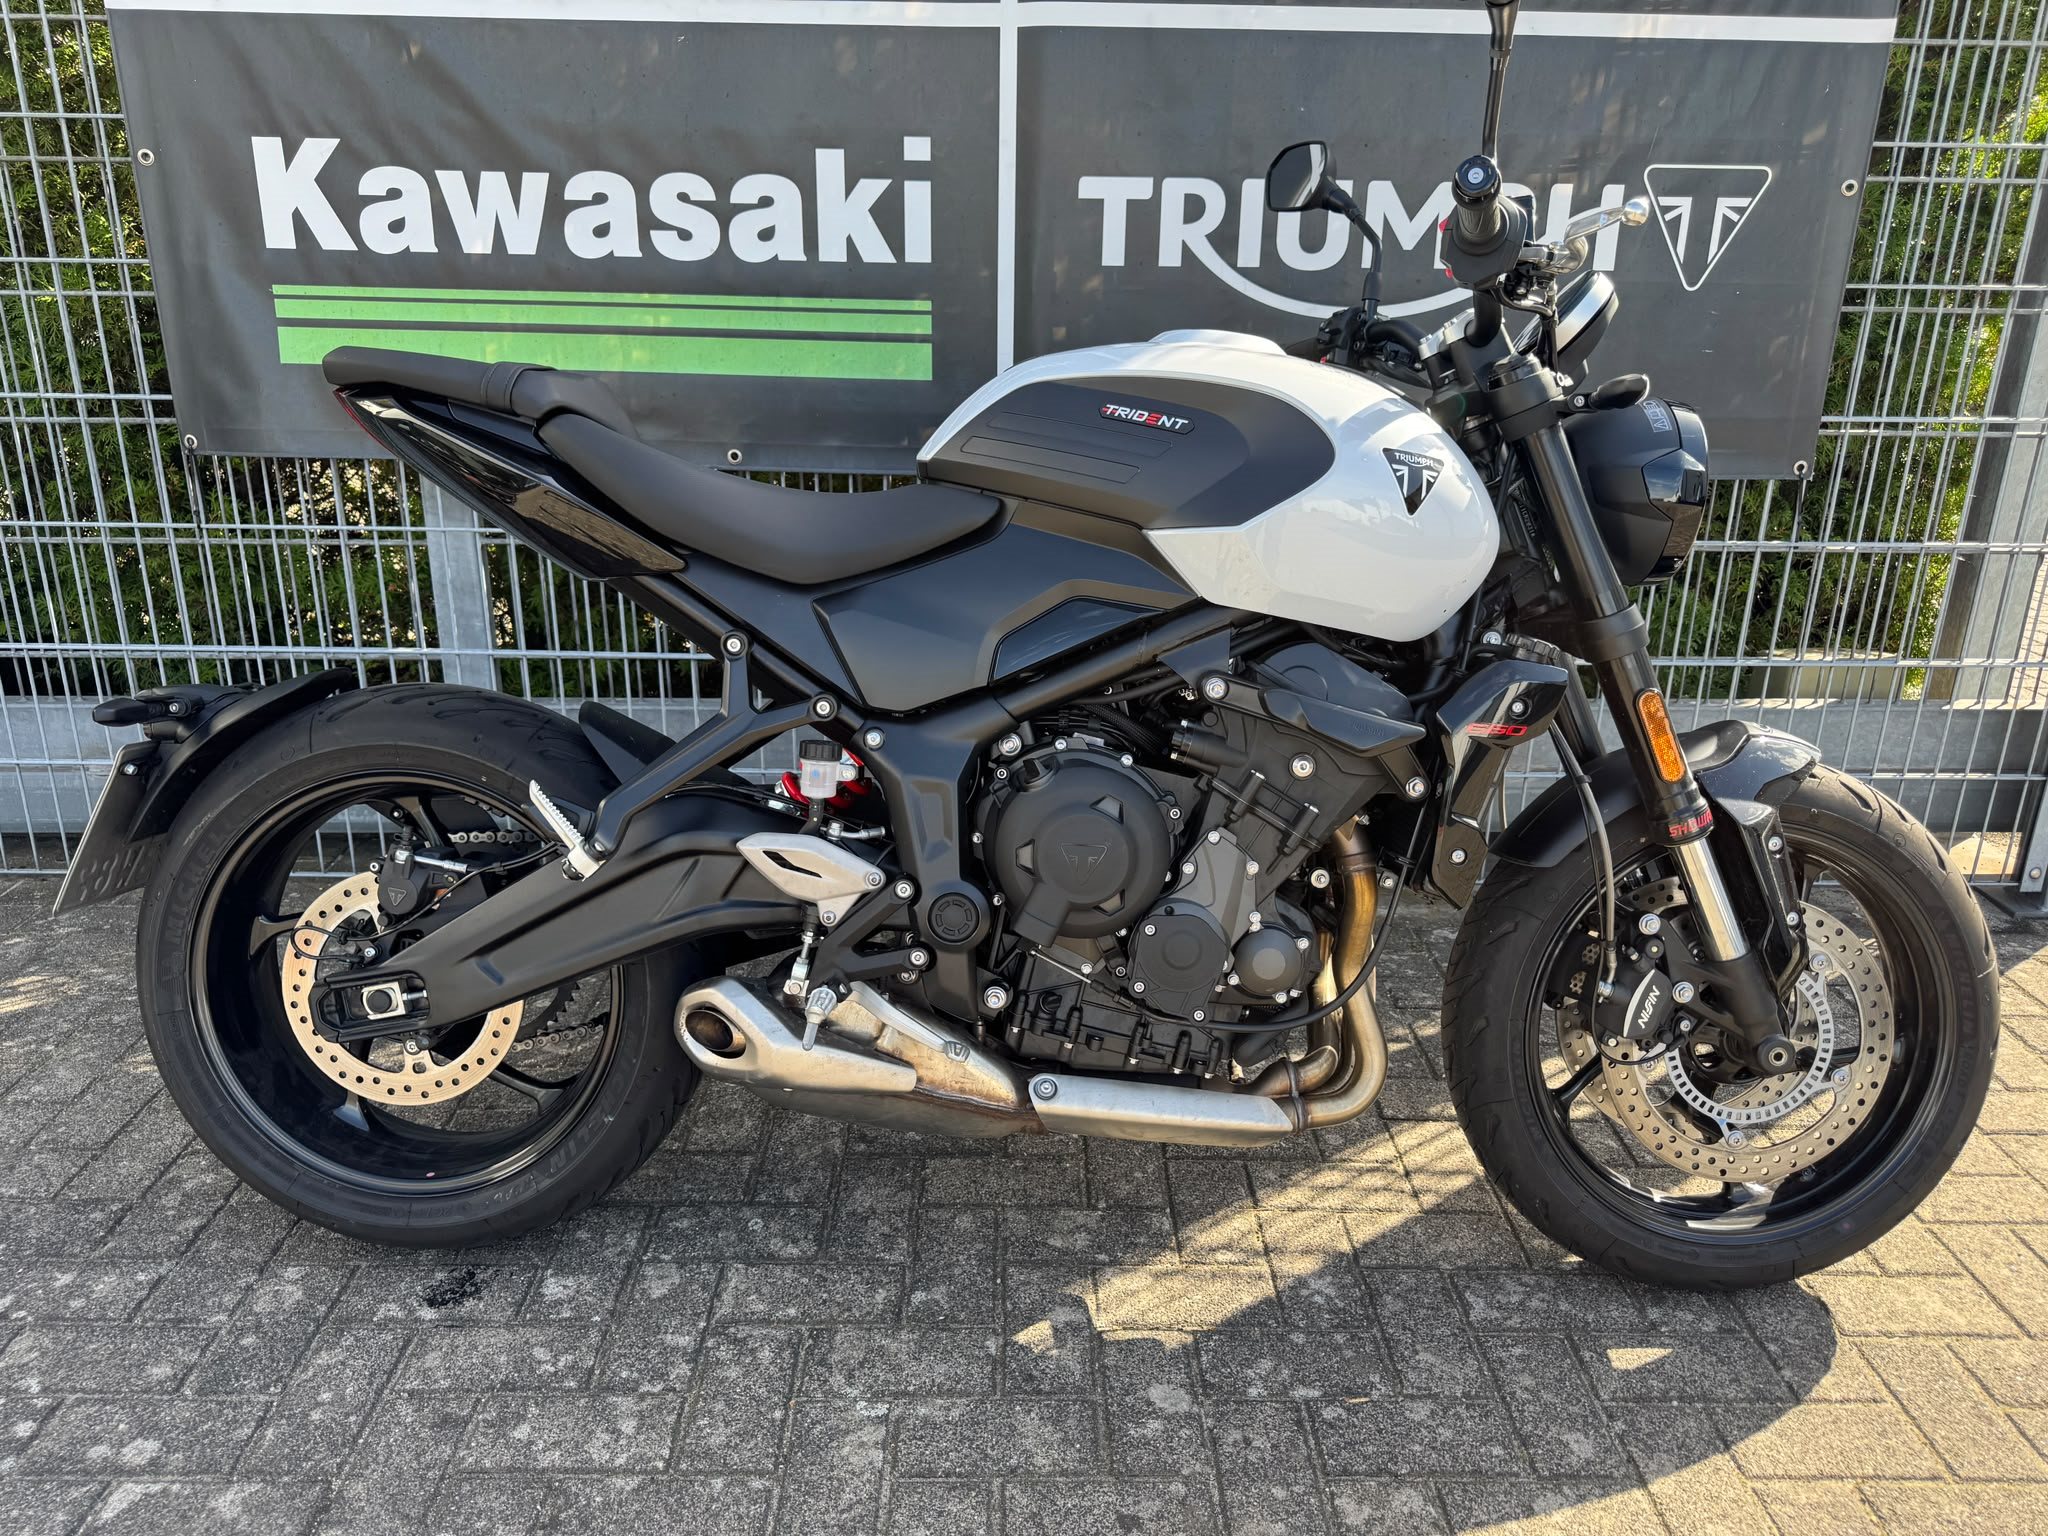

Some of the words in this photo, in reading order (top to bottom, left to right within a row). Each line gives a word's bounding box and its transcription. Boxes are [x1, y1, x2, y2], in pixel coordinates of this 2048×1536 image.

[251, 136, 932, 264] Kawasaki
[1078, 176, 1626, 319] TRIUMH
[1102, 403, 1189, 430] TRIDENT
[1394, 452, 1434, 467] TRIUMPH
[1668, 807, 1713, 838] SHOWA
[1637, 984, 1661, 1029] NISSIN
